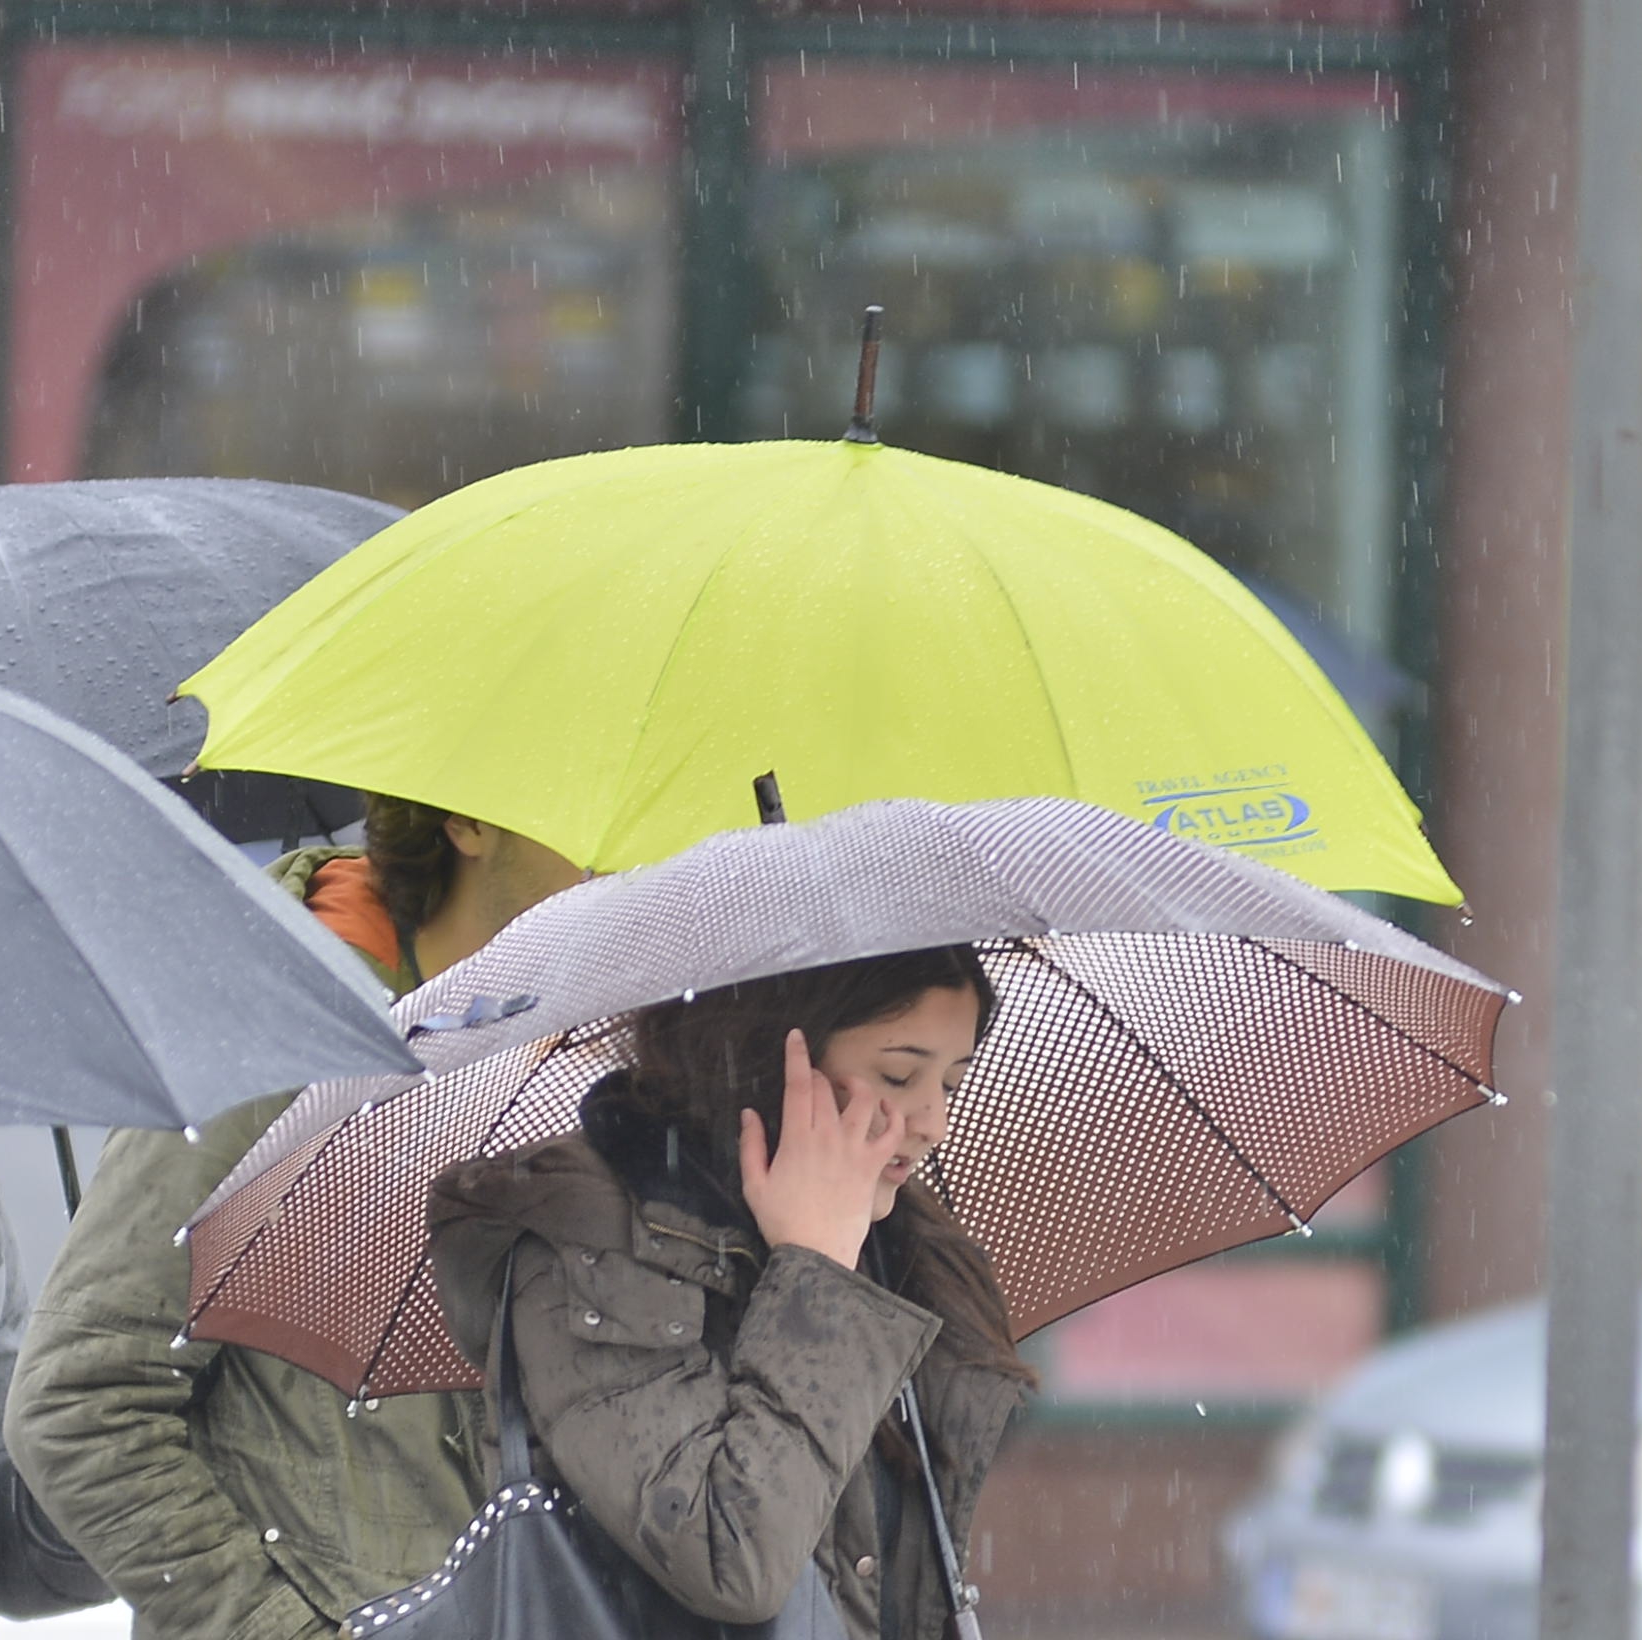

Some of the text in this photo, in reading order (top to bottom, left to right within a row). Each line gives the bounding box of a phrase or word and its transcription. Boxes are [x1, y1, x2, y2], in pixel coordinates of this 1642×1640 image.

[1133, 764, 1288, 794] TRAVEL AGENCY
[1177, 800, 1286, 831] ATLAS
